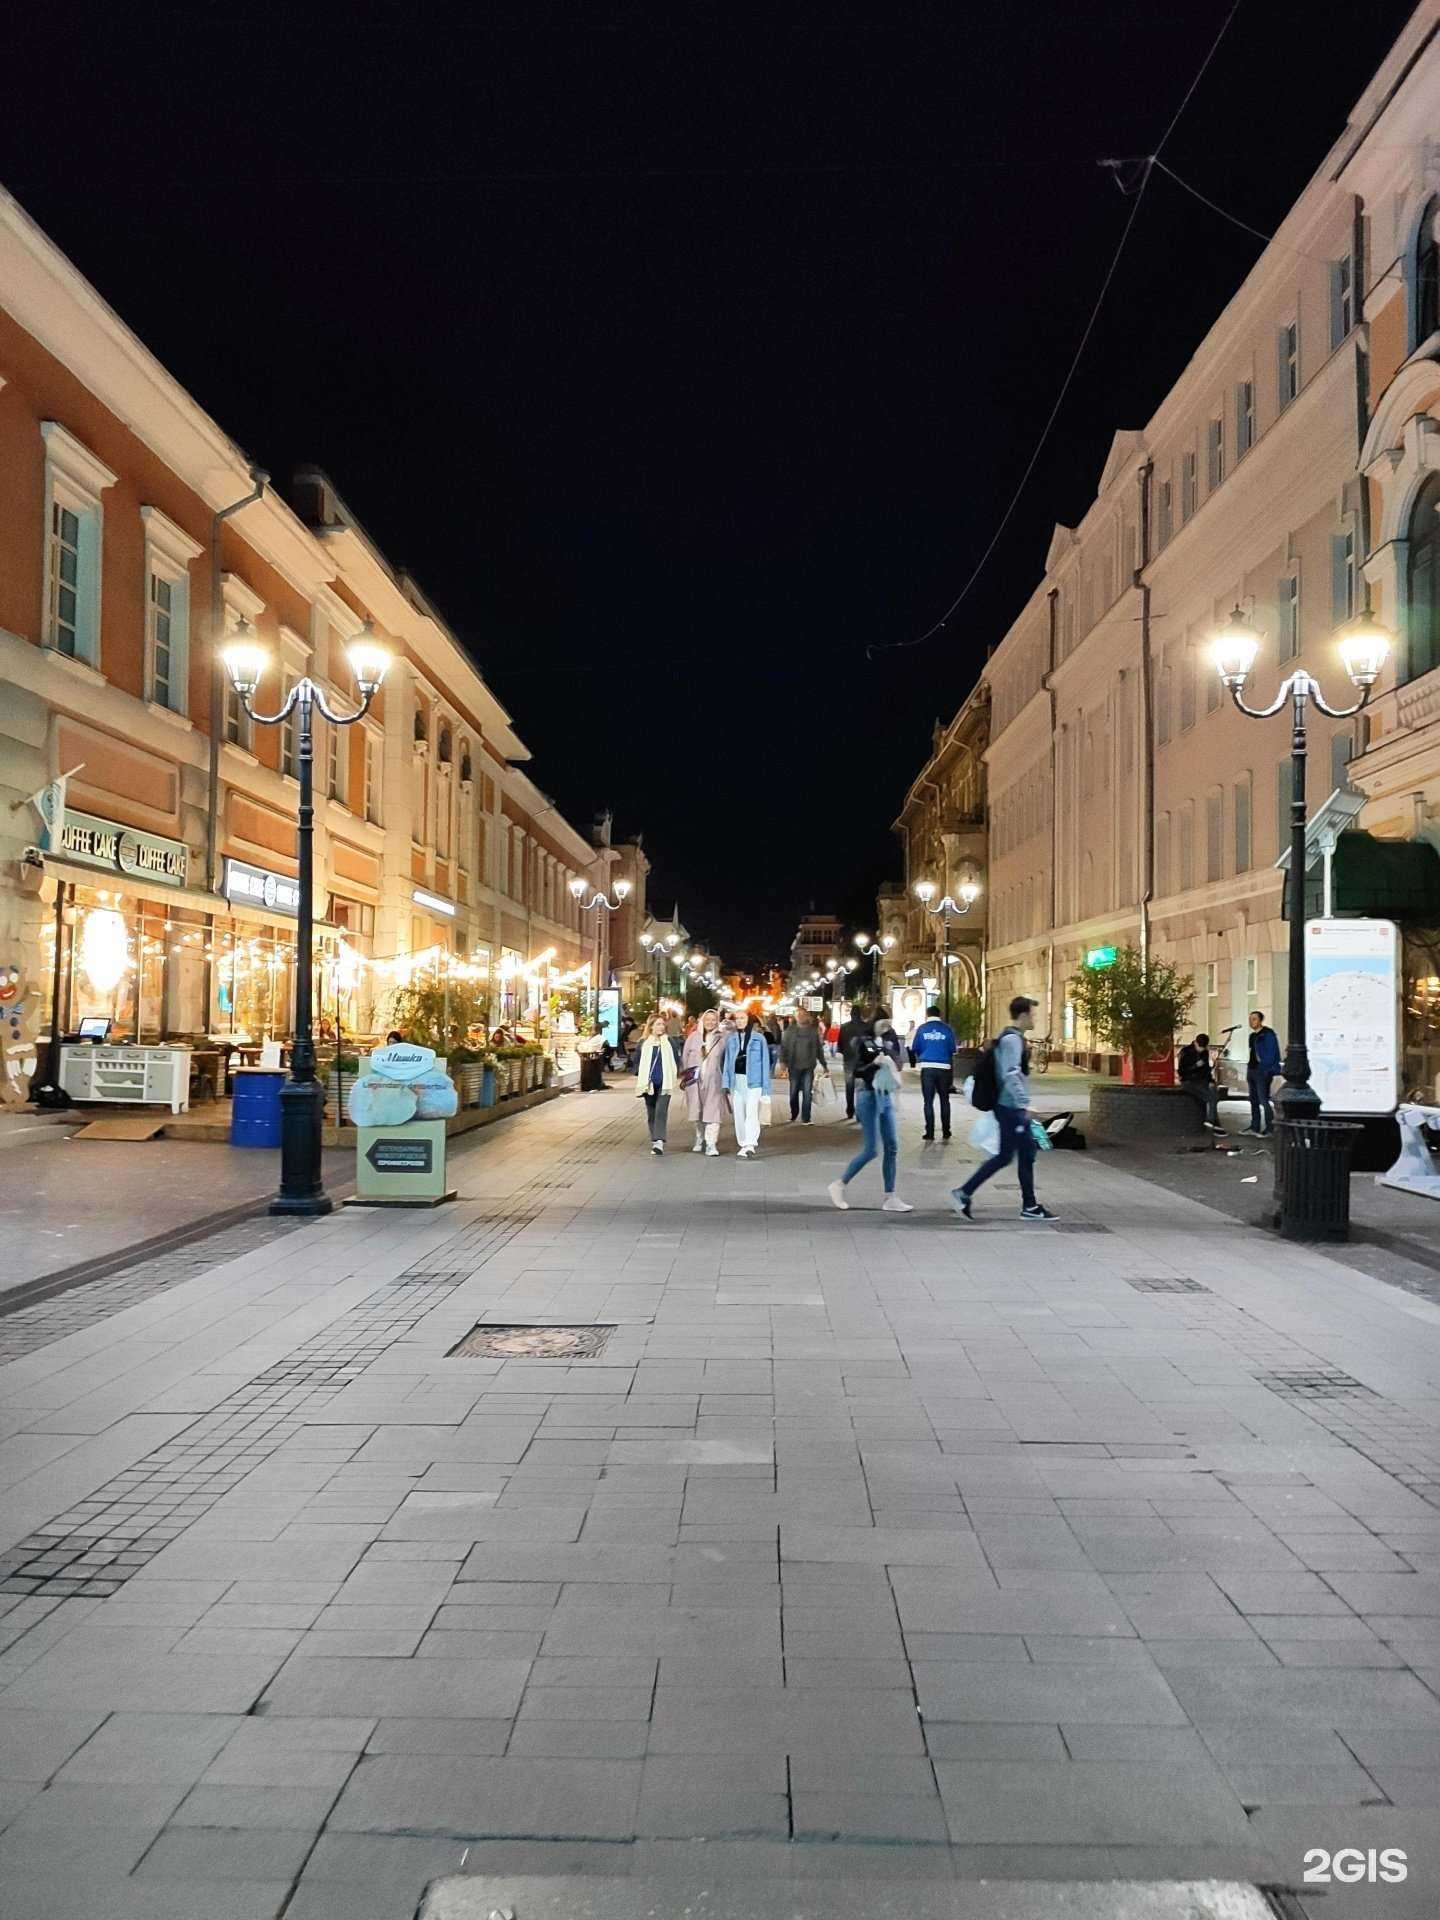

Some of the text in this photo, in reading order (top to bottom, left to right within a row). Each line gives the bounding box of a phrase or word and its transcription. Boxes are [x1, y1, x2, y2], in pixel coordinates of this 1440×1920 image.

[93, 831, 118, 861] CAKE
[139, 844, 166, 871] COFFEE
[166, 850, 186, 876] CAKE
